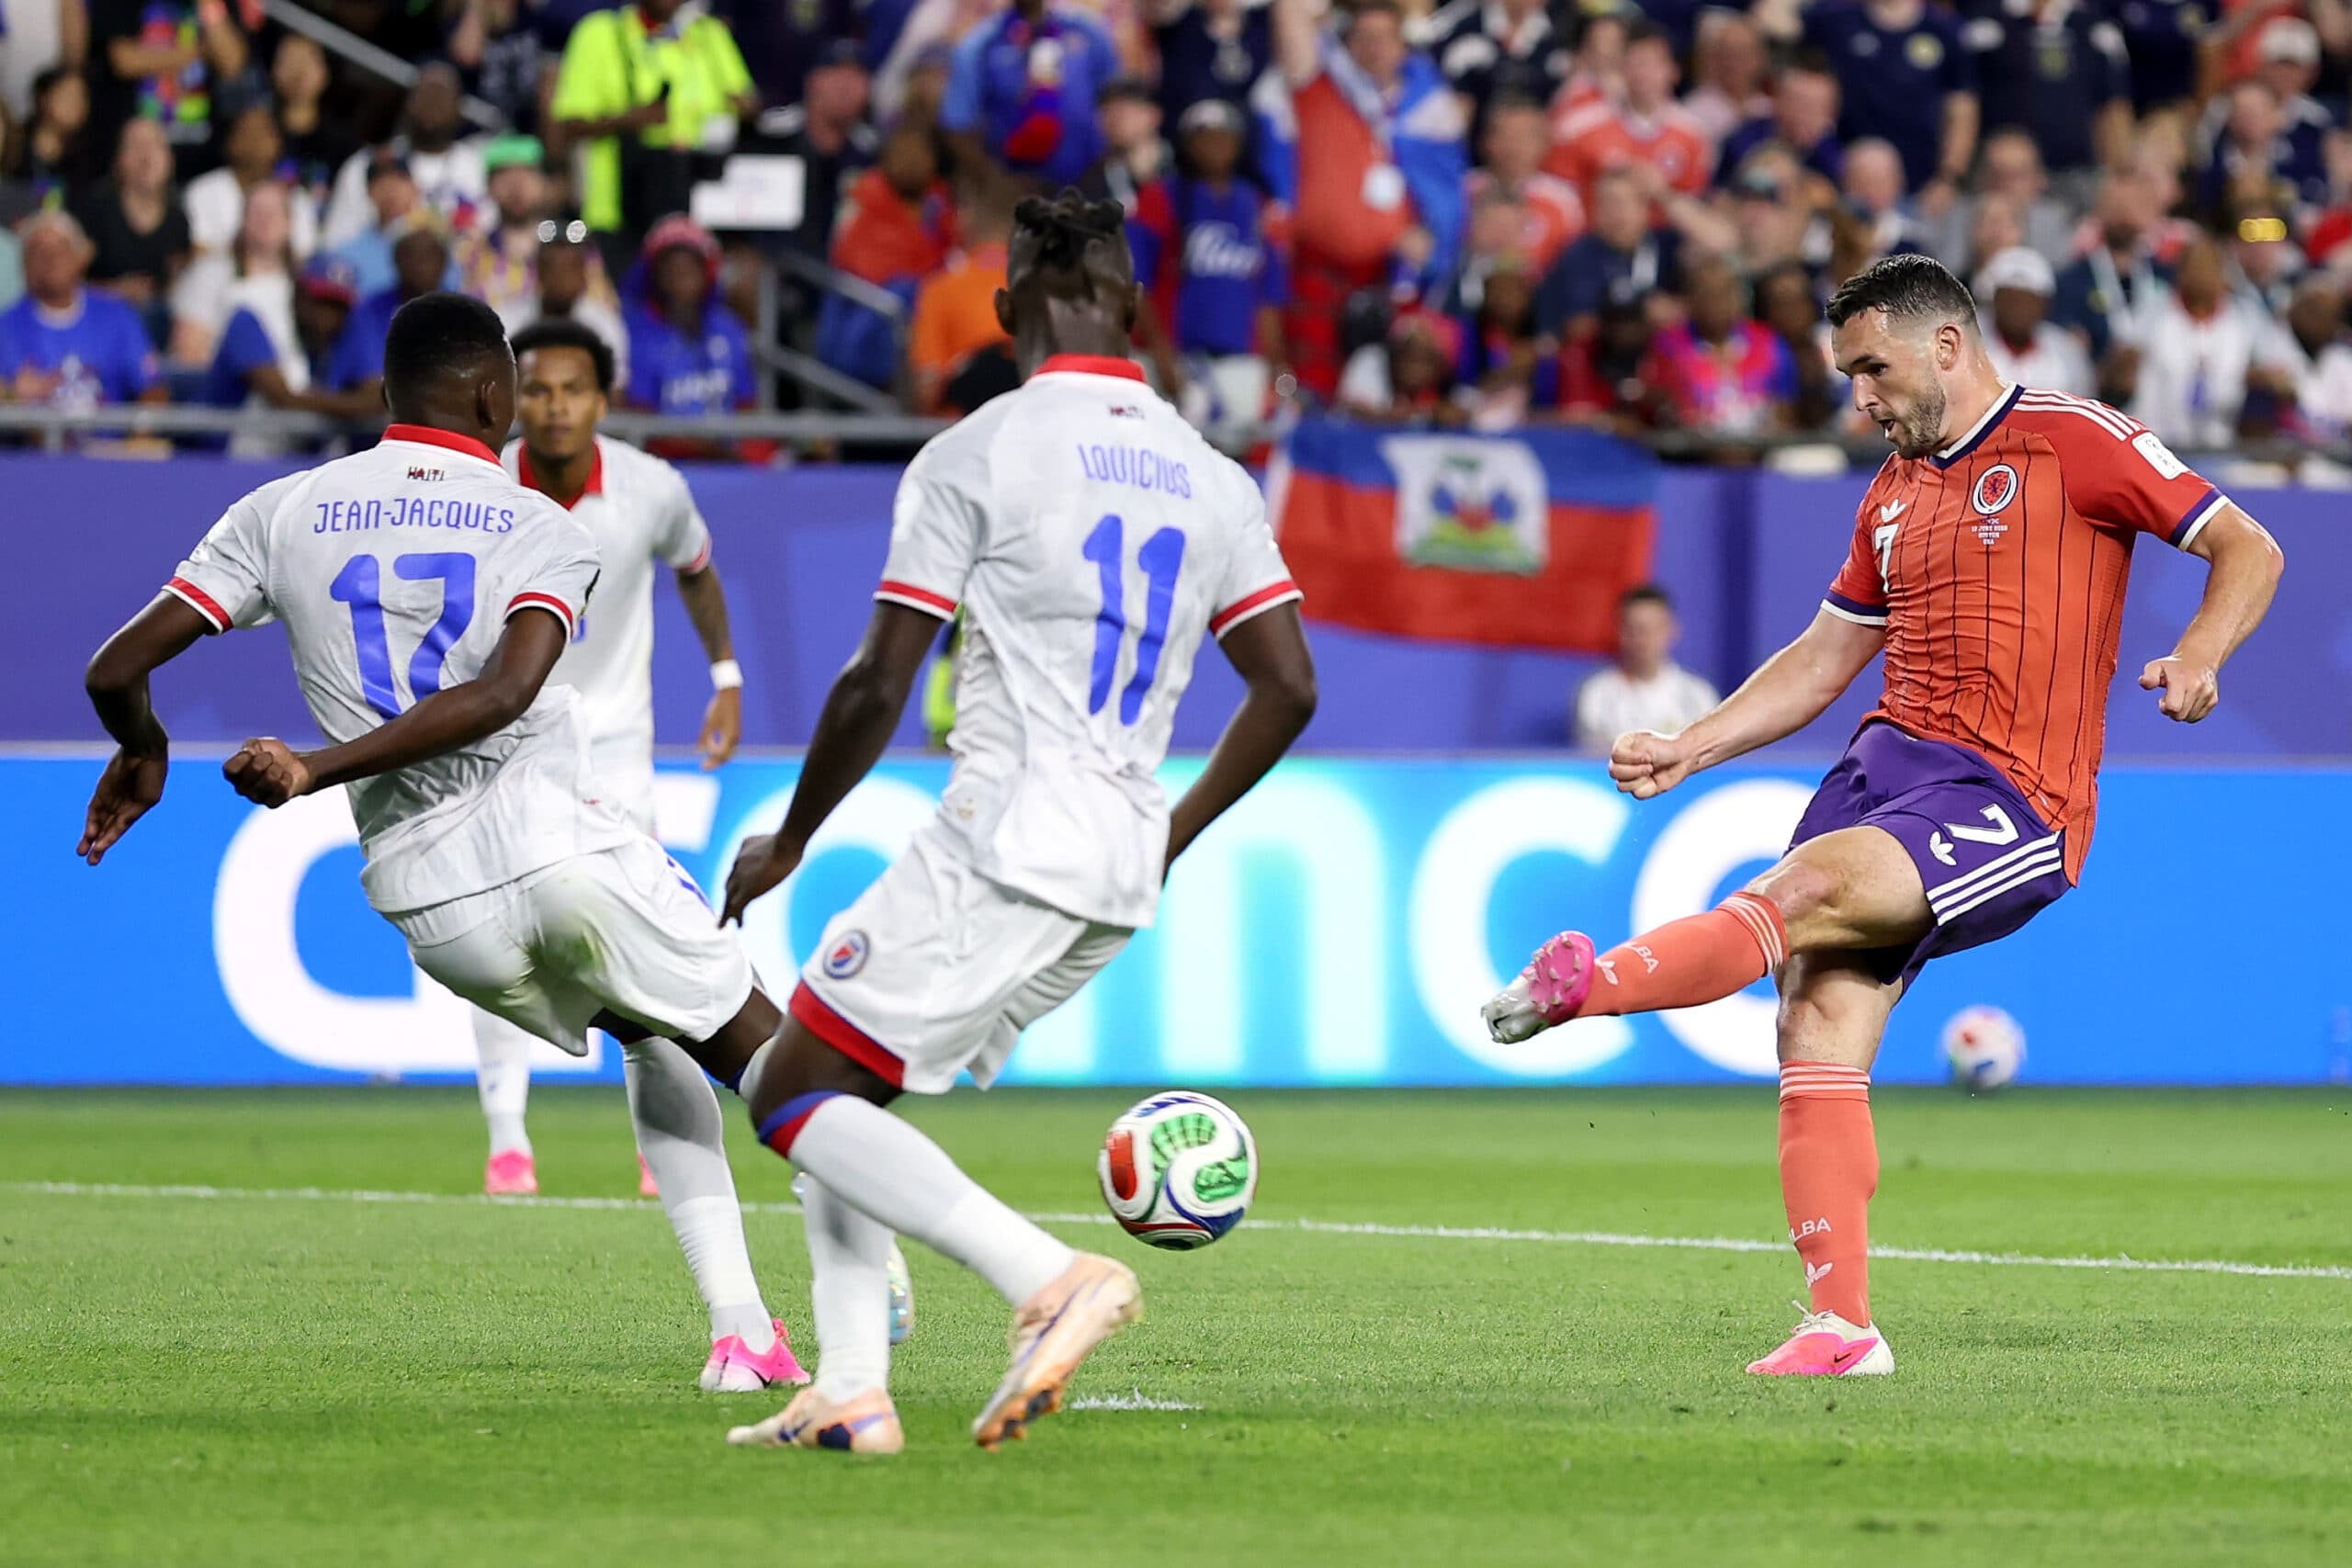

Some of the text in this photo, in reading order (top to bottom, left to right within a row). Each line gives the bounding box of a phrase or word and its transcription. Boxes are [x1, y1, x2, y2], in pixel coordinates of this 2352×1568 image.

[407, 466, 445, 481] HAITI
[1078, 445, 1191, 499] LOUICIUS
[313, 498, 514, 533] JEAN-JACQUES
[1874, 523, 1900, 593] 7
[329, 552, 477, 726] 17
[1082, 514, 1186, 727] 11
[1943, 803, 2020, 846] 7
[1624, 941, 1659, 974] LBA
[1788, 1217, 1832, 1243] LBA
